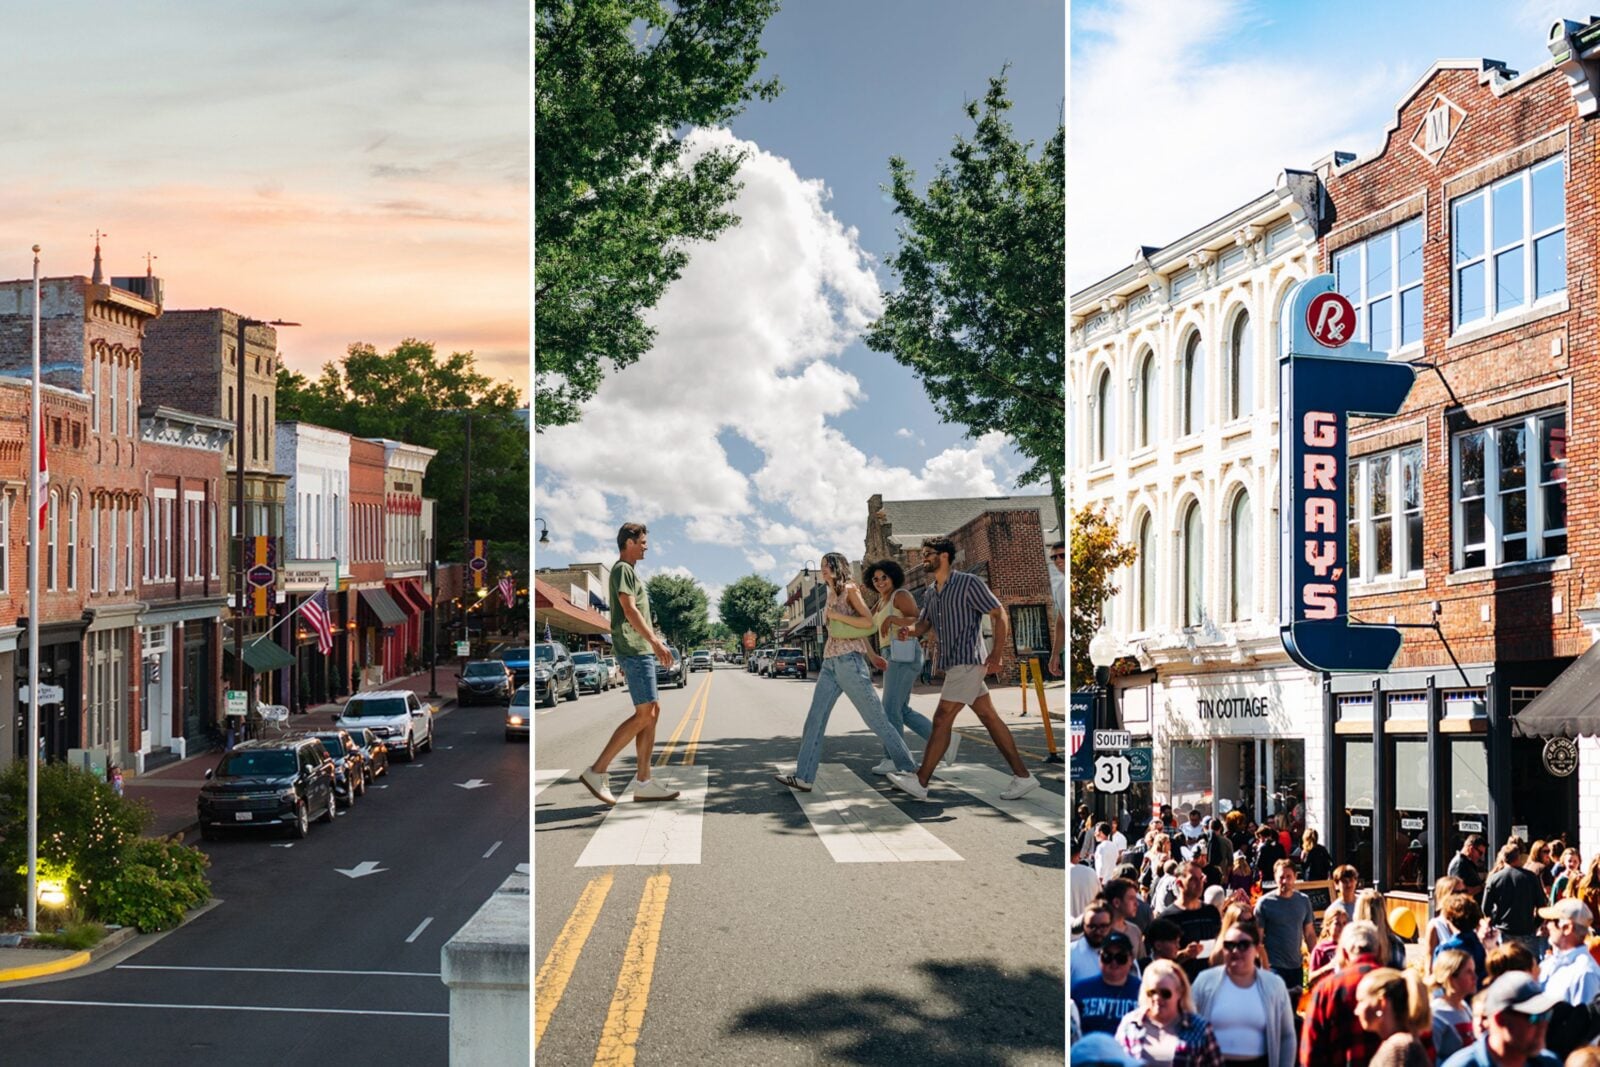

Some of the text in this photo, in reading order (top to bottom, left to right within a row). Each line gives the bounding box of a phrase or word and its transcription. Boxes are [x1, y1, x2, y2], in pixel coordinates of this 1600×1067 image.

[1303, 410, 1343, 620] GRAY'S
[1197, 697, 1268, 719] TIN COTTAGE
[1096, 733, 1129, 746] SOUTH
[1101, 763, 1122, 783] 31
